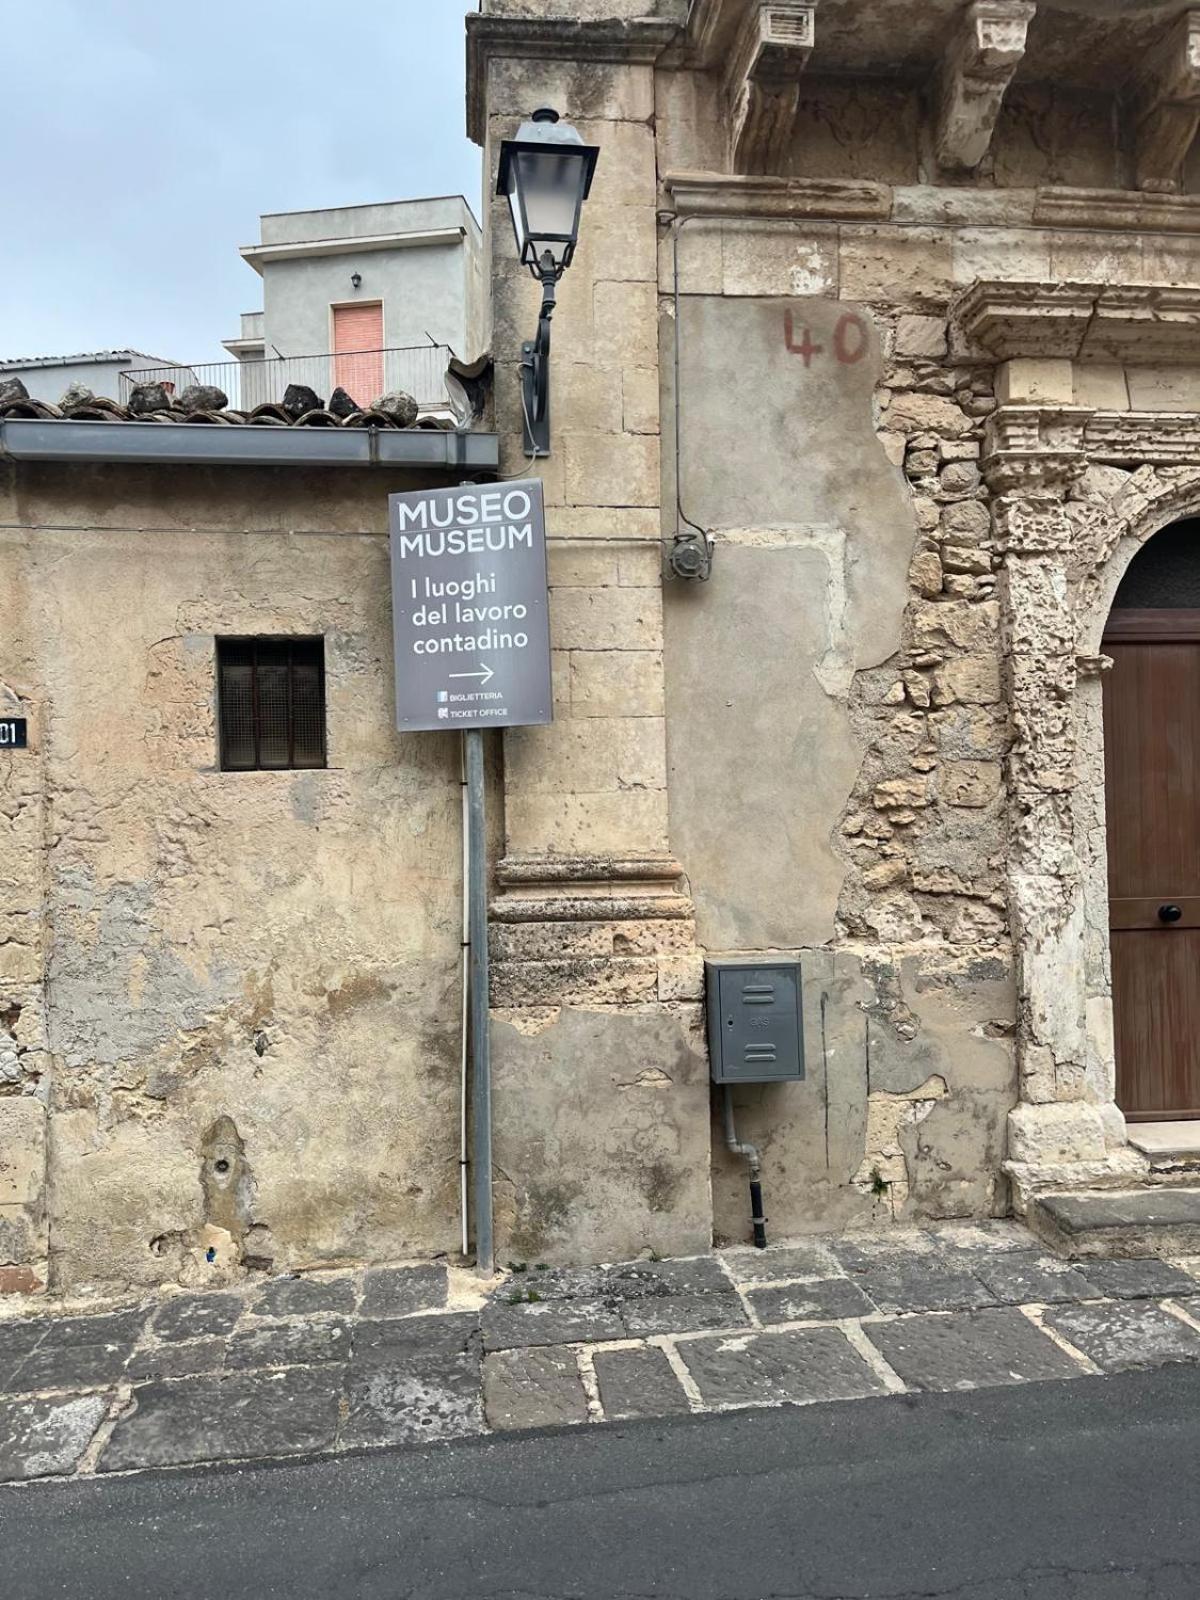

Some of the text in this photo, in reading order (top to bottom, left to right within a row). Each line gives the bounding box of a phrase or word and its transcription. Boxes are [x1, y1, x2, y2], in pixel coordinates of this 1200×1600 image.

[784, 308, 870, 368] 40
[398, 489, 531, 532] MUSEO
[399, 524, 534, 559] MUSEUM
[411, 573, 496, 600] I luoghi
[412, 602, 528, 626] del lavoro
[413, 628, 529, 655] contadino
[449, 691, 504, 702] BIGLIETTERIA
[450, 707, 508, 718] TICKET OFFICE
